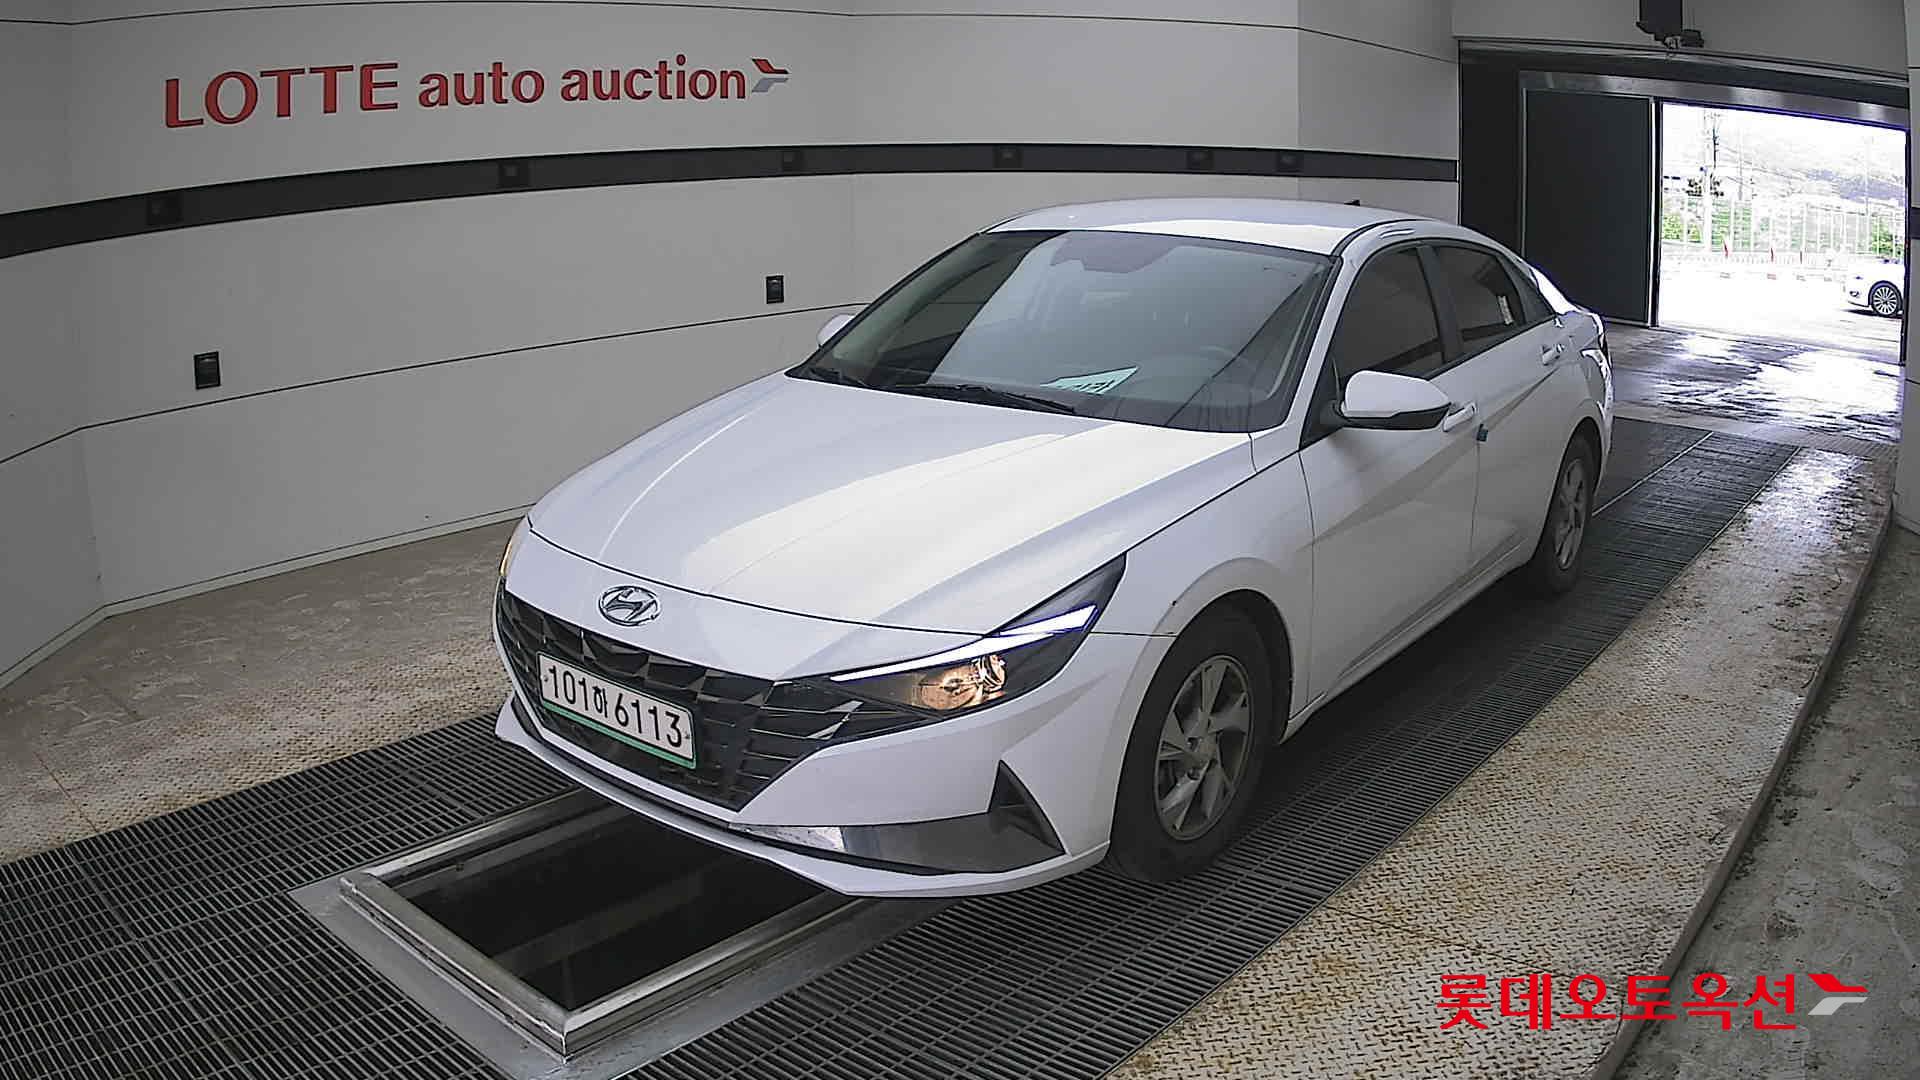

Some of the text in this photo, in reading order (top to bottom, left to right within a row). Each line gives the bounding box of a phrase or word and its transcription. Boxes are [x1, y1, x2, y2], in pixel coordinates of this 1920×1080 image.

[164, 55, 747, 129] LOTTE auto auction
